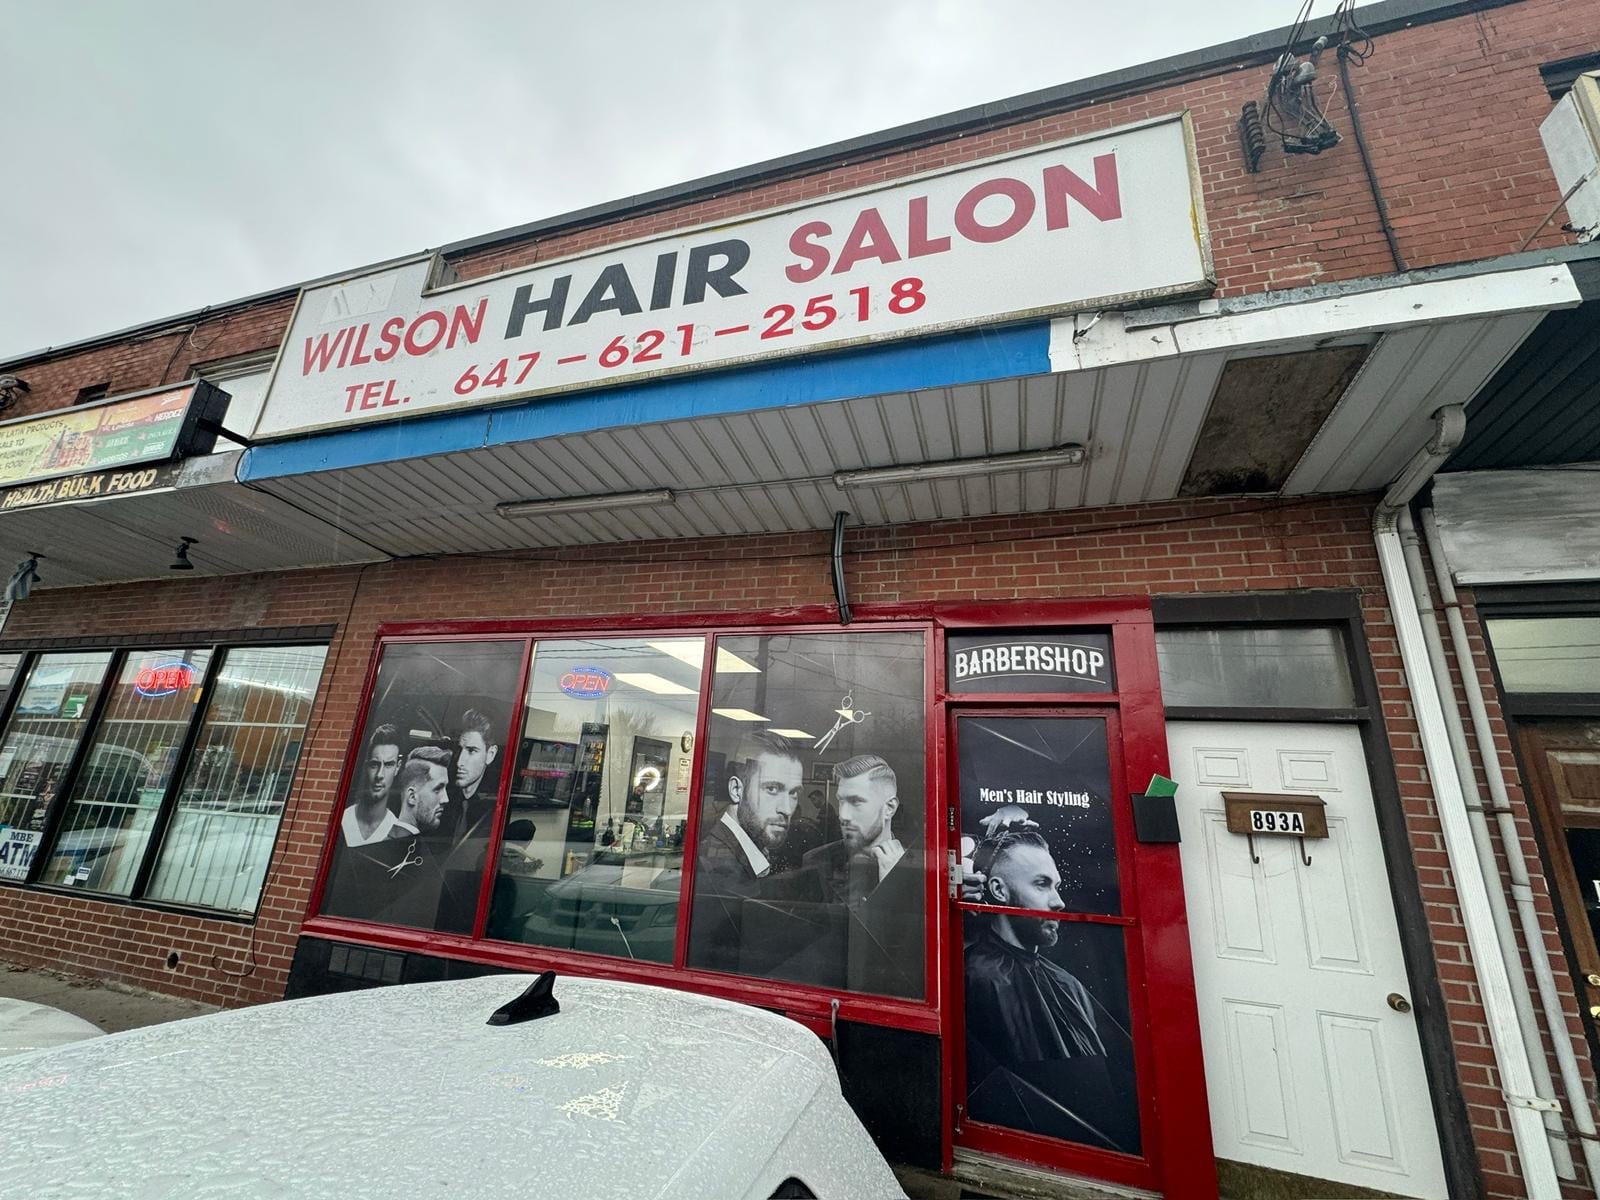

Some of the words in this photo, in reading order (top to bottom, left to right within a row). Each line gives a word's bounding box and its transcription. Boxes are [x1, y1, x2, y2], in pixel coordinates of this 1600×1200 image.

[302, 296, 489, 377] WILSON
[504, 238, 751, 340] HAIR
[785, 153, 1122, 284] SALON
[345, 379, 411, 414] TEL.
[1, 482, 58, 508] HEALTH
[56, 475, 105, 498] BULK
[107, 469, 157, 492] FOOD
[955, 645, 1105, 678] BARBERSHOP
[136, 669, 193, 689] OPEN
[560, 673, 609, 692] OPEN
[979, 788, 1013, 803] Men's
[1016, 789, 1043, 804] Hair
[1046, 790, 1090, 808] Styling
[1253, 811, 1303, 832] 893A
[10, 831, 34, 842] MBE
[0, 841, 38, 867] ATM
